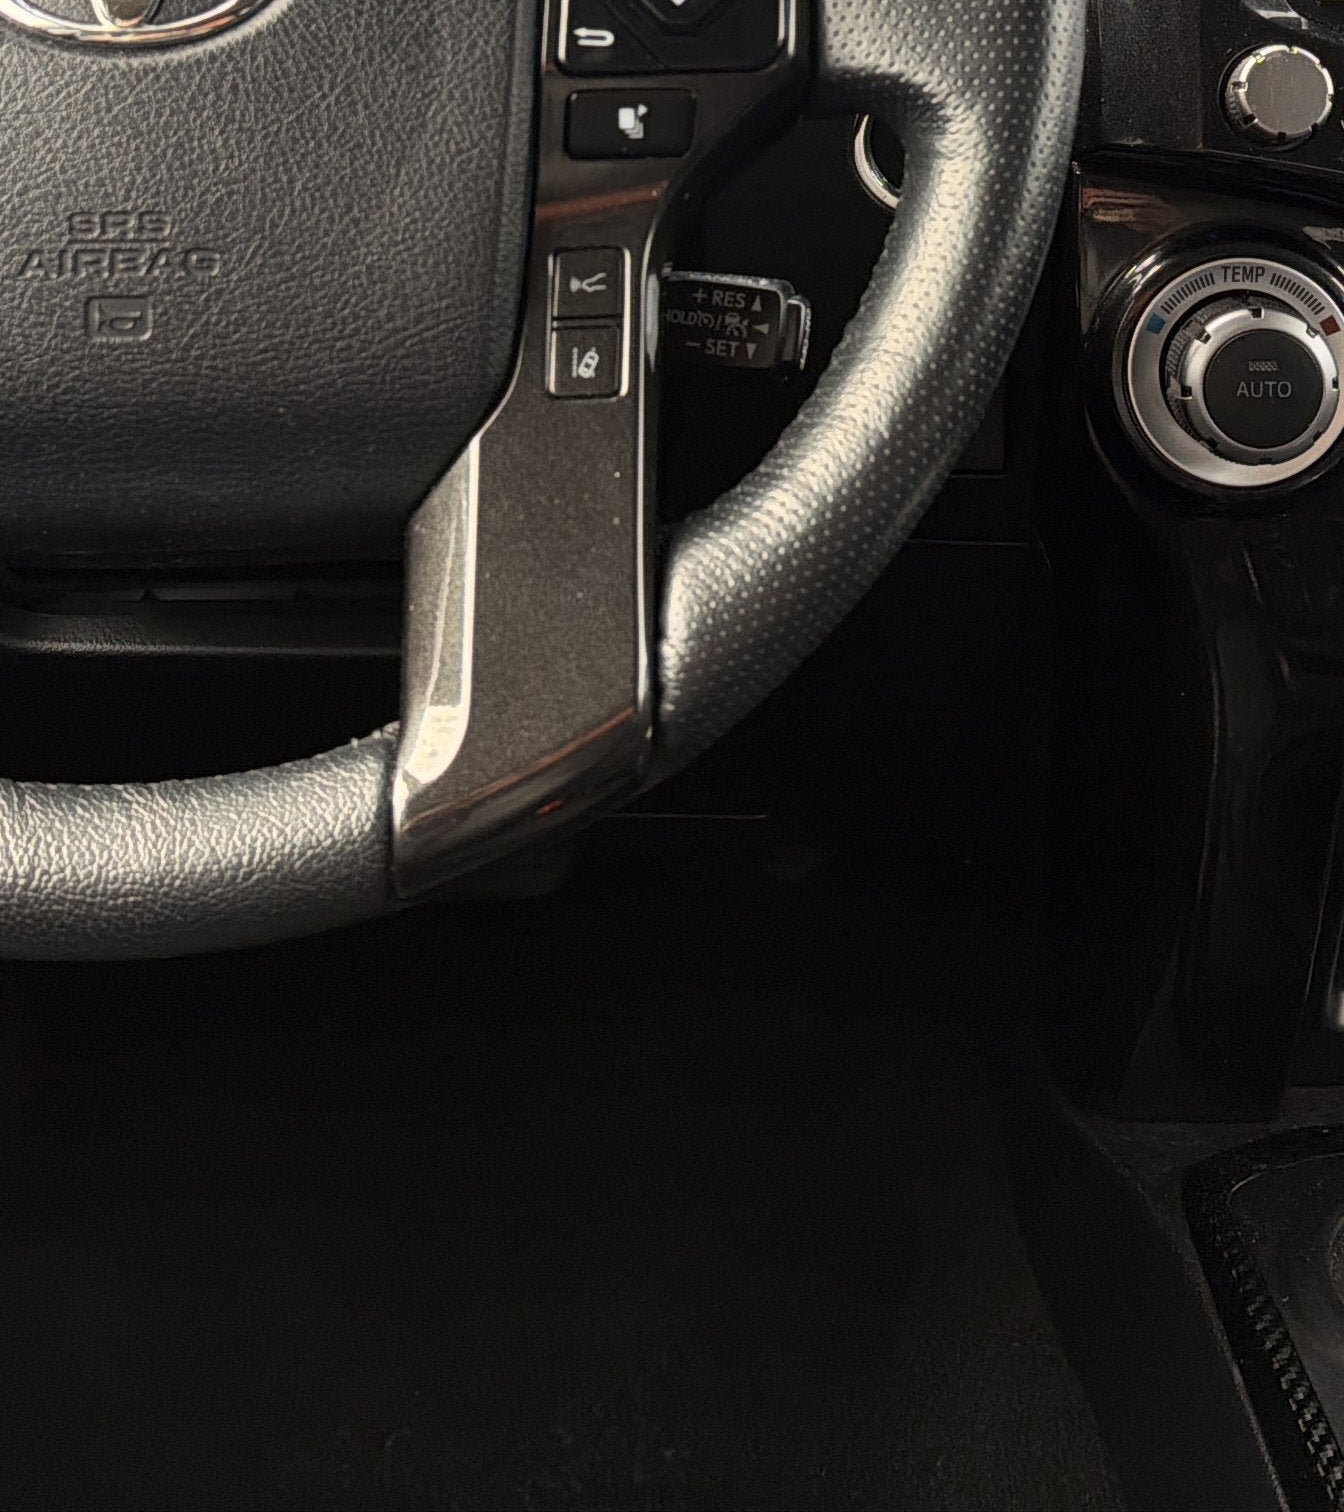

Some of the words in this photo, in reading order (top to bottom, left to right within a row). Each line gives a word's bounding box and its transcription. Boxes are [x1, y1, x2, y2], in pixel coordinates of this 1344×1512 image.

[67, 210, 172, 240] SRS
[17, 247, 222, 280] AIRBAG
[1220, 264, 1267, 285] TEMP
[711, 289, 747, 309] RES
[705, 339, 740, 358] SET
[1236, 381, 1292, 399] AUTO
